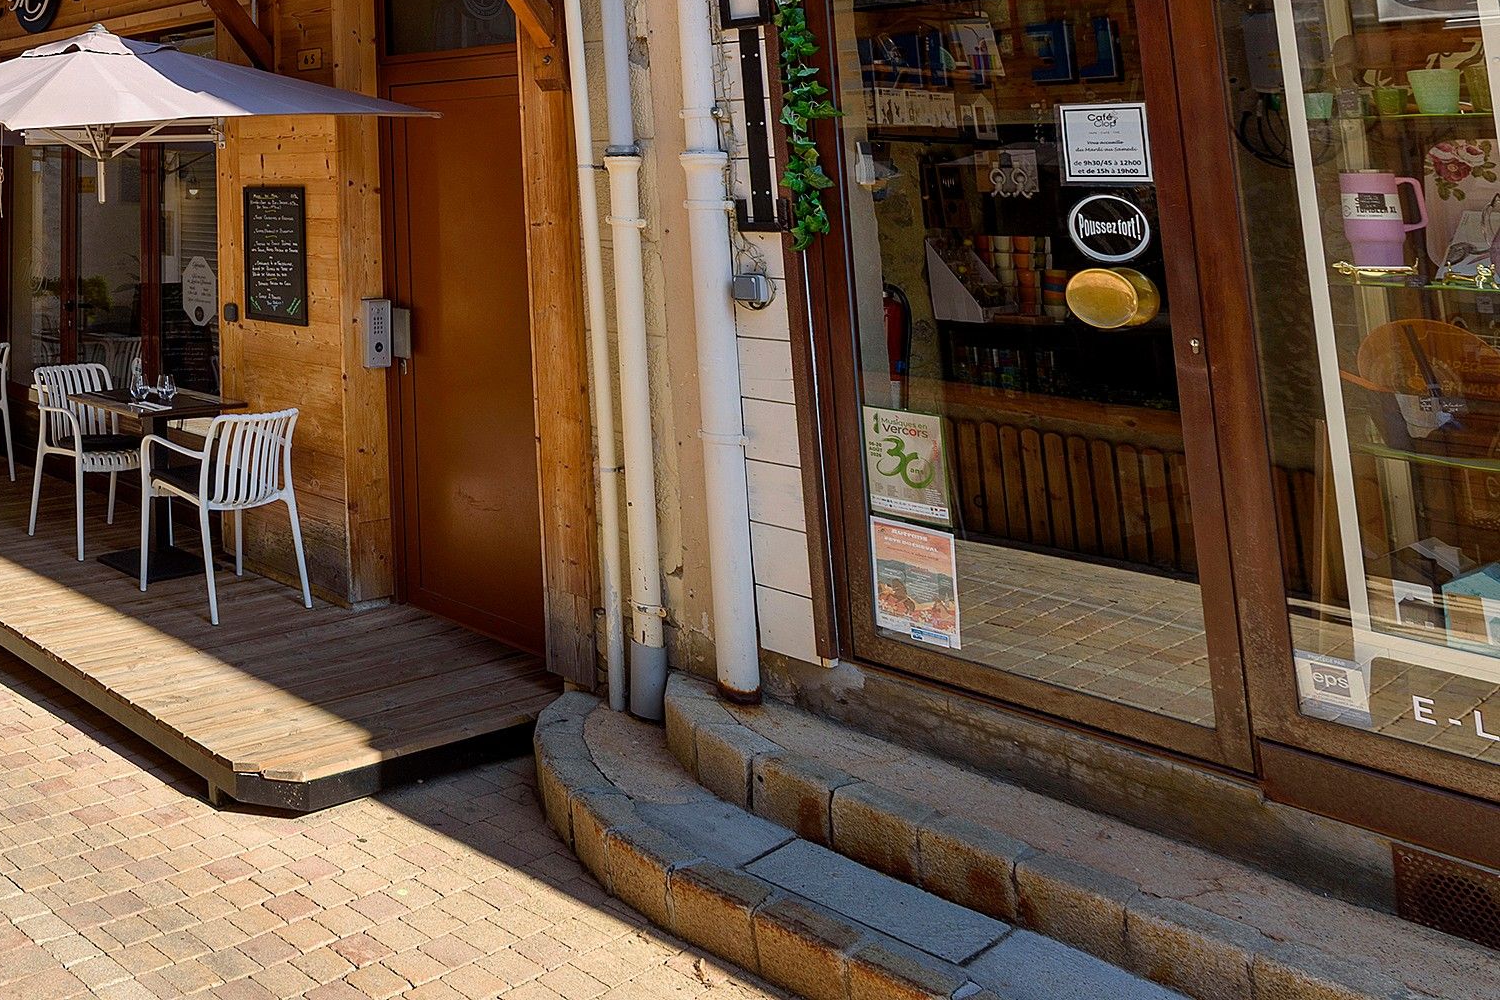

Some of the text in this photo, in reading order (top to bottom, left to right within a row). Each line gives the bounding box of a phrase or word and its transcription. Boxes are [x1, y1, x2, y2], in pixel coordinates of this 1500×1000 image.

[1087, 113, 1113, 121] Café
[1077, 213, 1117, 239] Poussez
[881, 416, 928, 430] Musiques en
[882, 423, 929, 439] Vercors
[877, 435, 936, 489] 30
[910, 467, 925, 475] ans
[1312, 672, 1350, 690] eps
